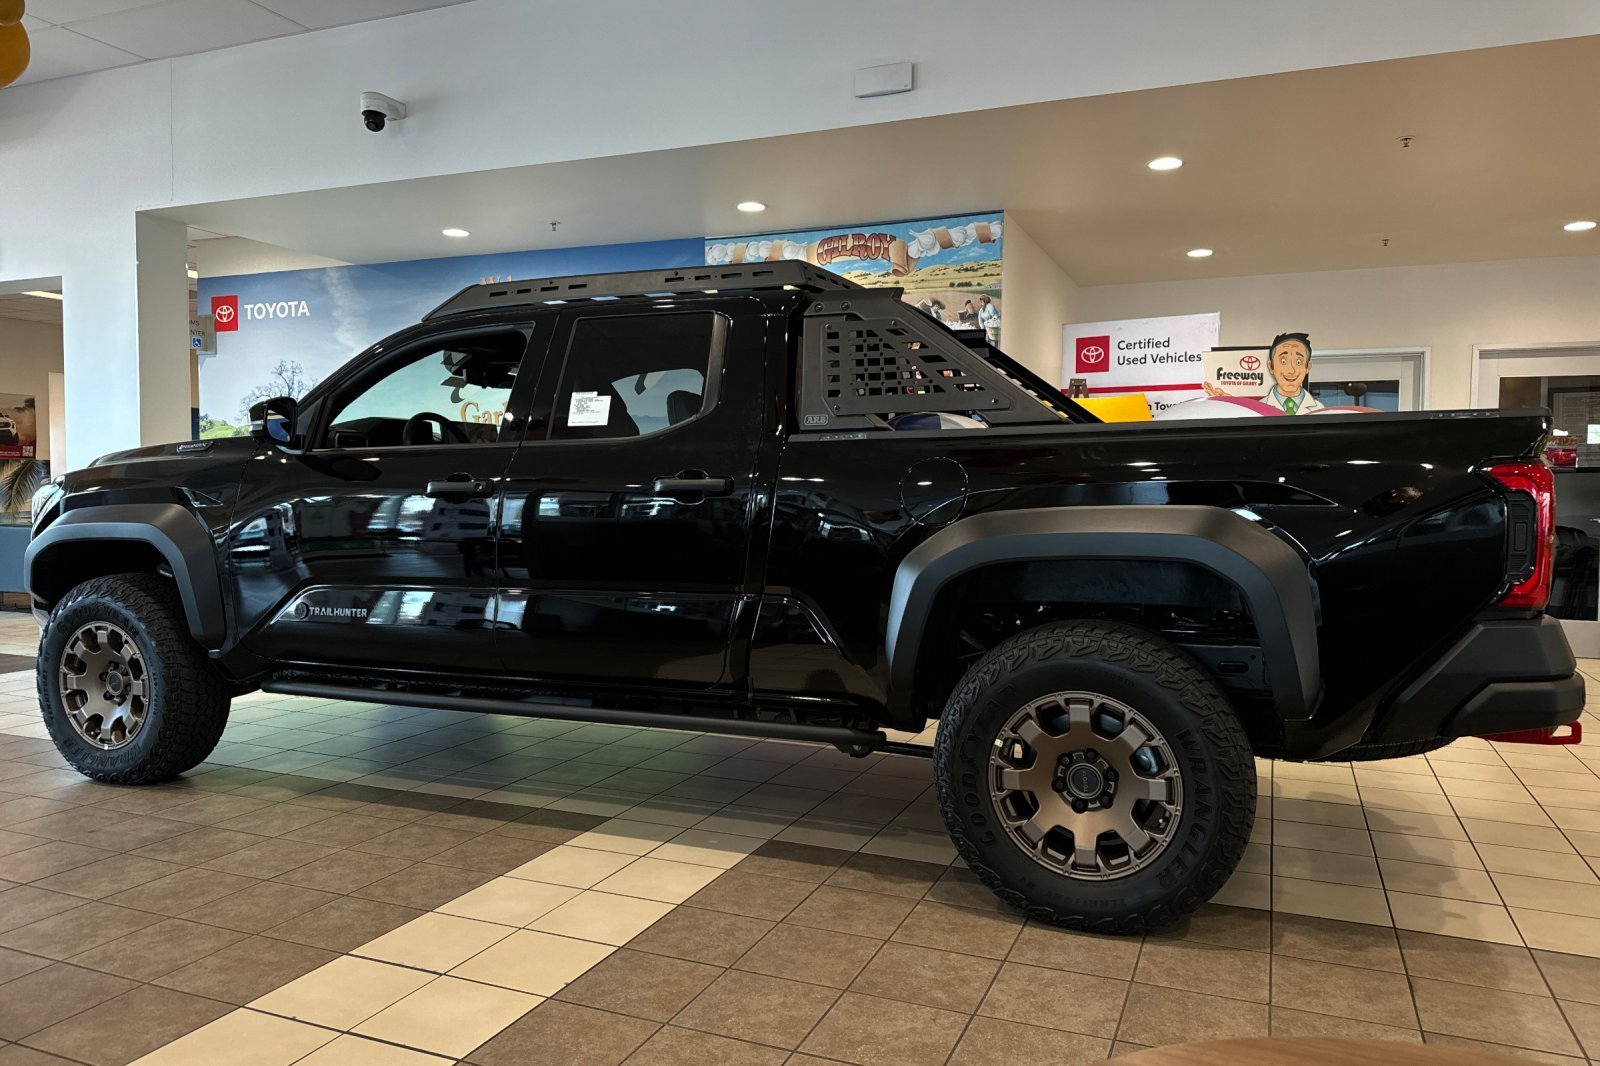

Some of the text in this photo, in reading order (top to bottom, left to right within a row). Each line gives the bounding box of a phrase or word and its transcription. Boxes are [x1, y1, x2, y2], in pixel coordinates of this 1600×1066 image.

[817, 233, 896, 265] GILROY
[244, 301, 310, 320] TOYOTA
[1117, 337, 1170, 351] Certified
[1117, 352, 1202, 366] Used Vehicles
[460, 401, 508, 425] Gar
[309, 607, 368, 618] TRAILHUNTER
[1155, 727, 1208, 890] WRANGLER
